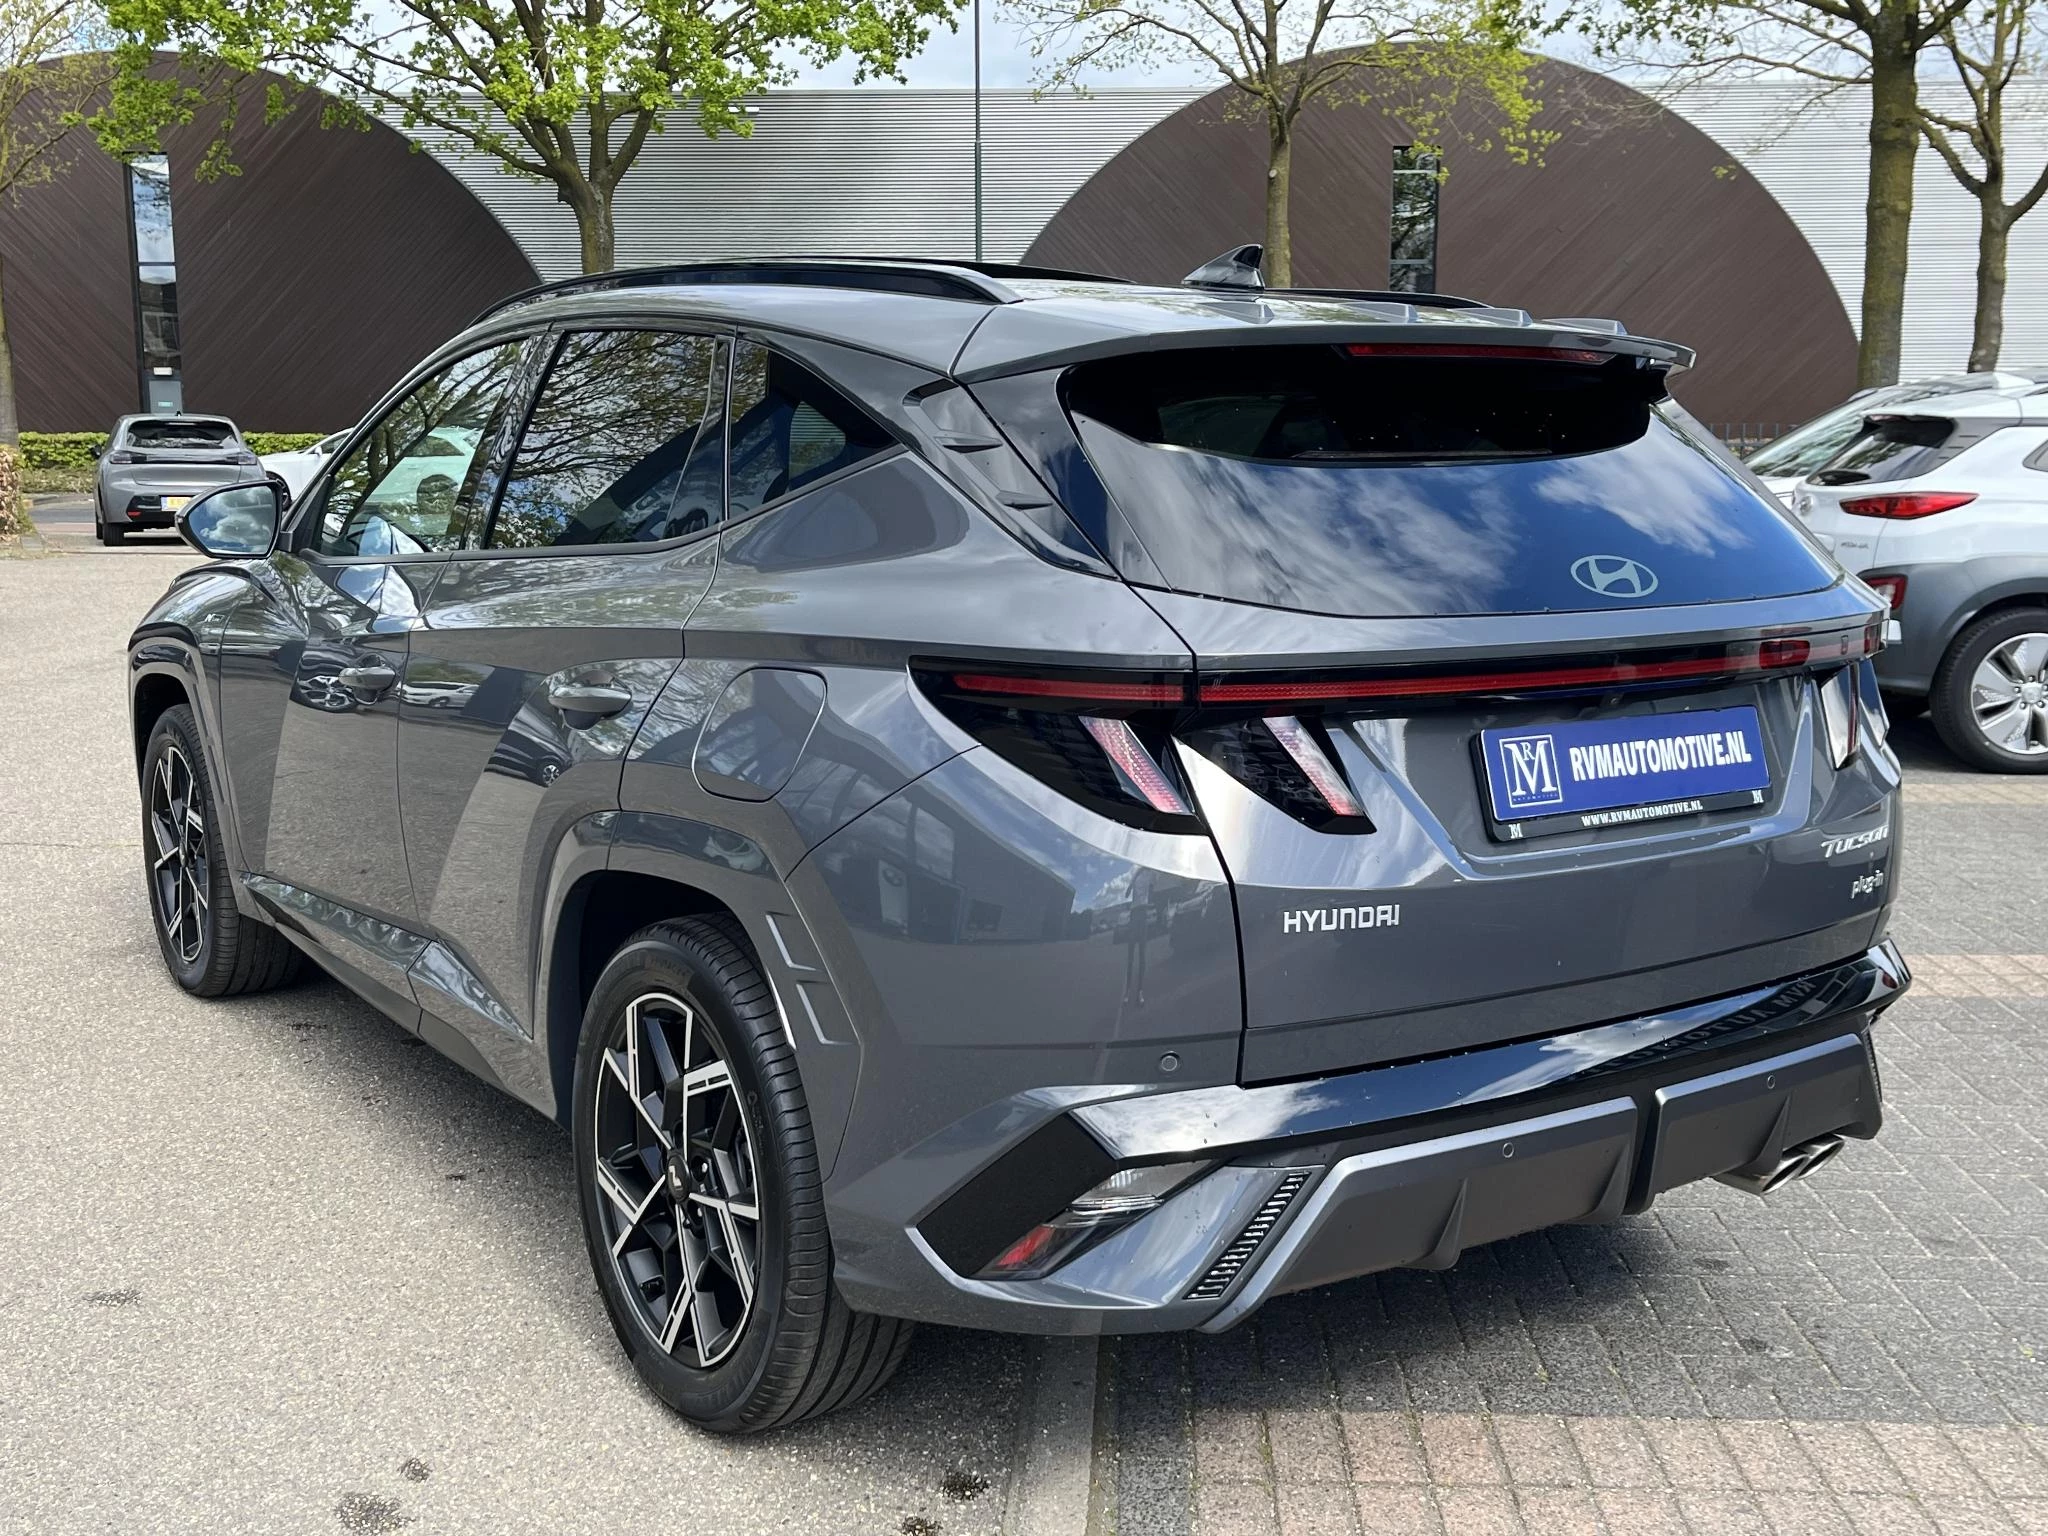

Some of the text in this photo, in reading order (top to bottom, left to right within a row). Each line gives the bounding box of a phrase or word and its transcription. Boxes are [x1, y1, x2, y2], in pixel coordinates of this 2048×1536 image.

[1569, 730, 1752, 782] RVMAUTOMOTIVE.NL
[1581, 799, 1703, 827] WWW.RVMAUTOMOTIVE.NL
[1283, 904, 1400, 933] HYUNDAI
